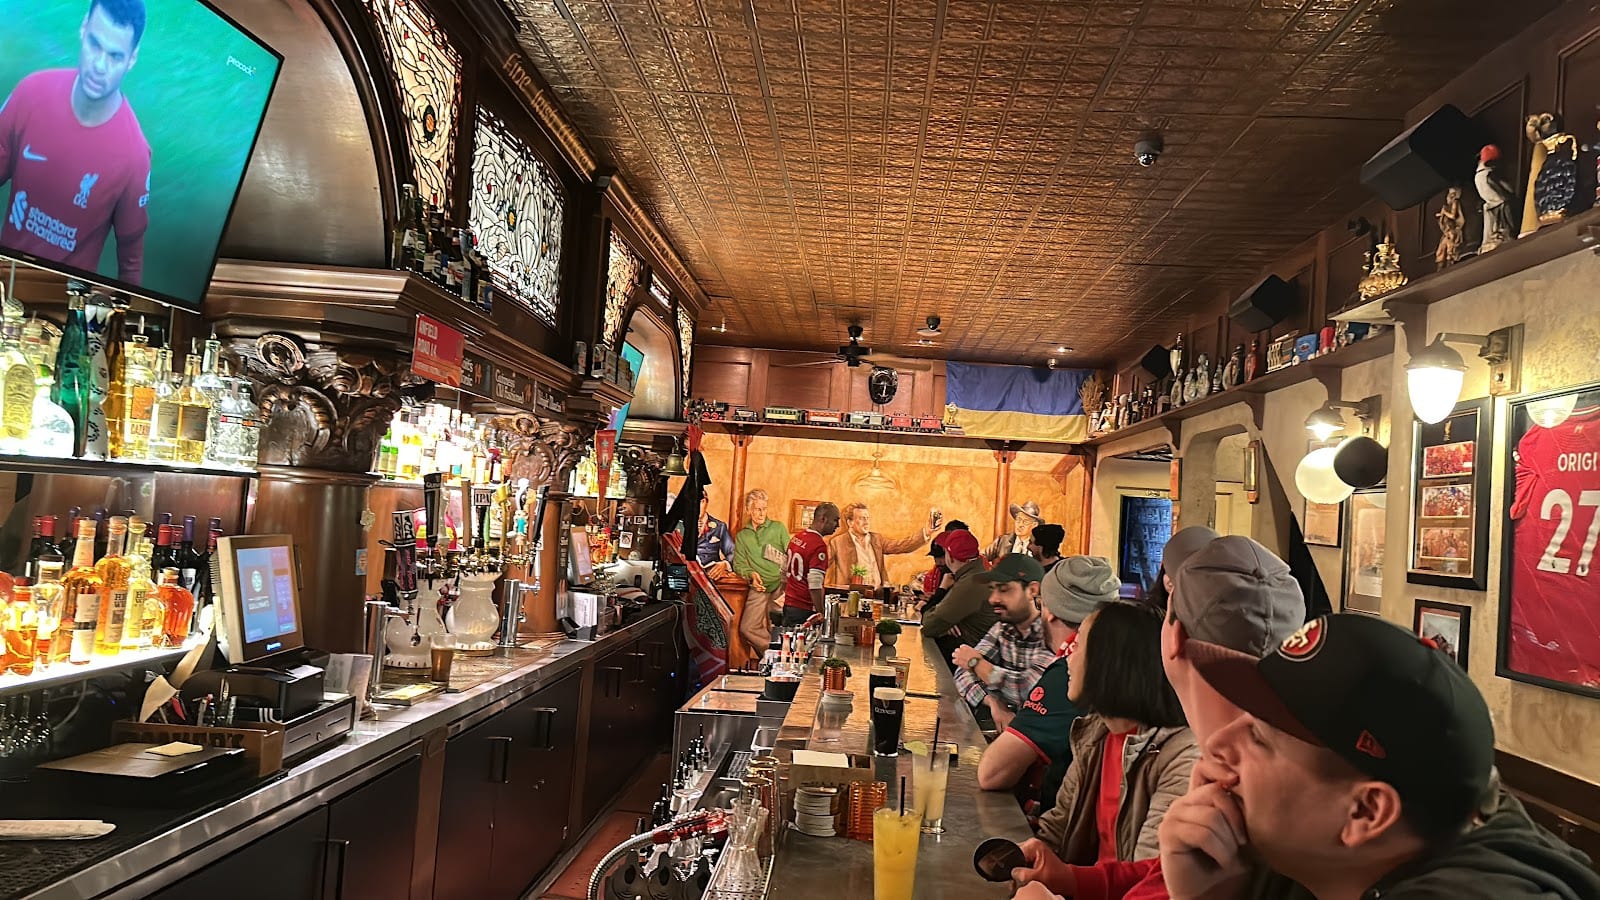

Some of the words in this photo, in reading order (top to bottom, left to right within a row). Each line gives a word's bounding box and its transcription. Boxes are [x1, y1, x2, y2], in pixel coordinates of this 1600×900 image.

[226, 56, 254, 76] peacock
[25, 219, 77, 252] chartered
[28, 206, 78, 239] standard
[1557, 452, 1598, 472] ORIGI
[475, 493, 490, 503] IPA
[1536, 488, 1600, 577] 27
